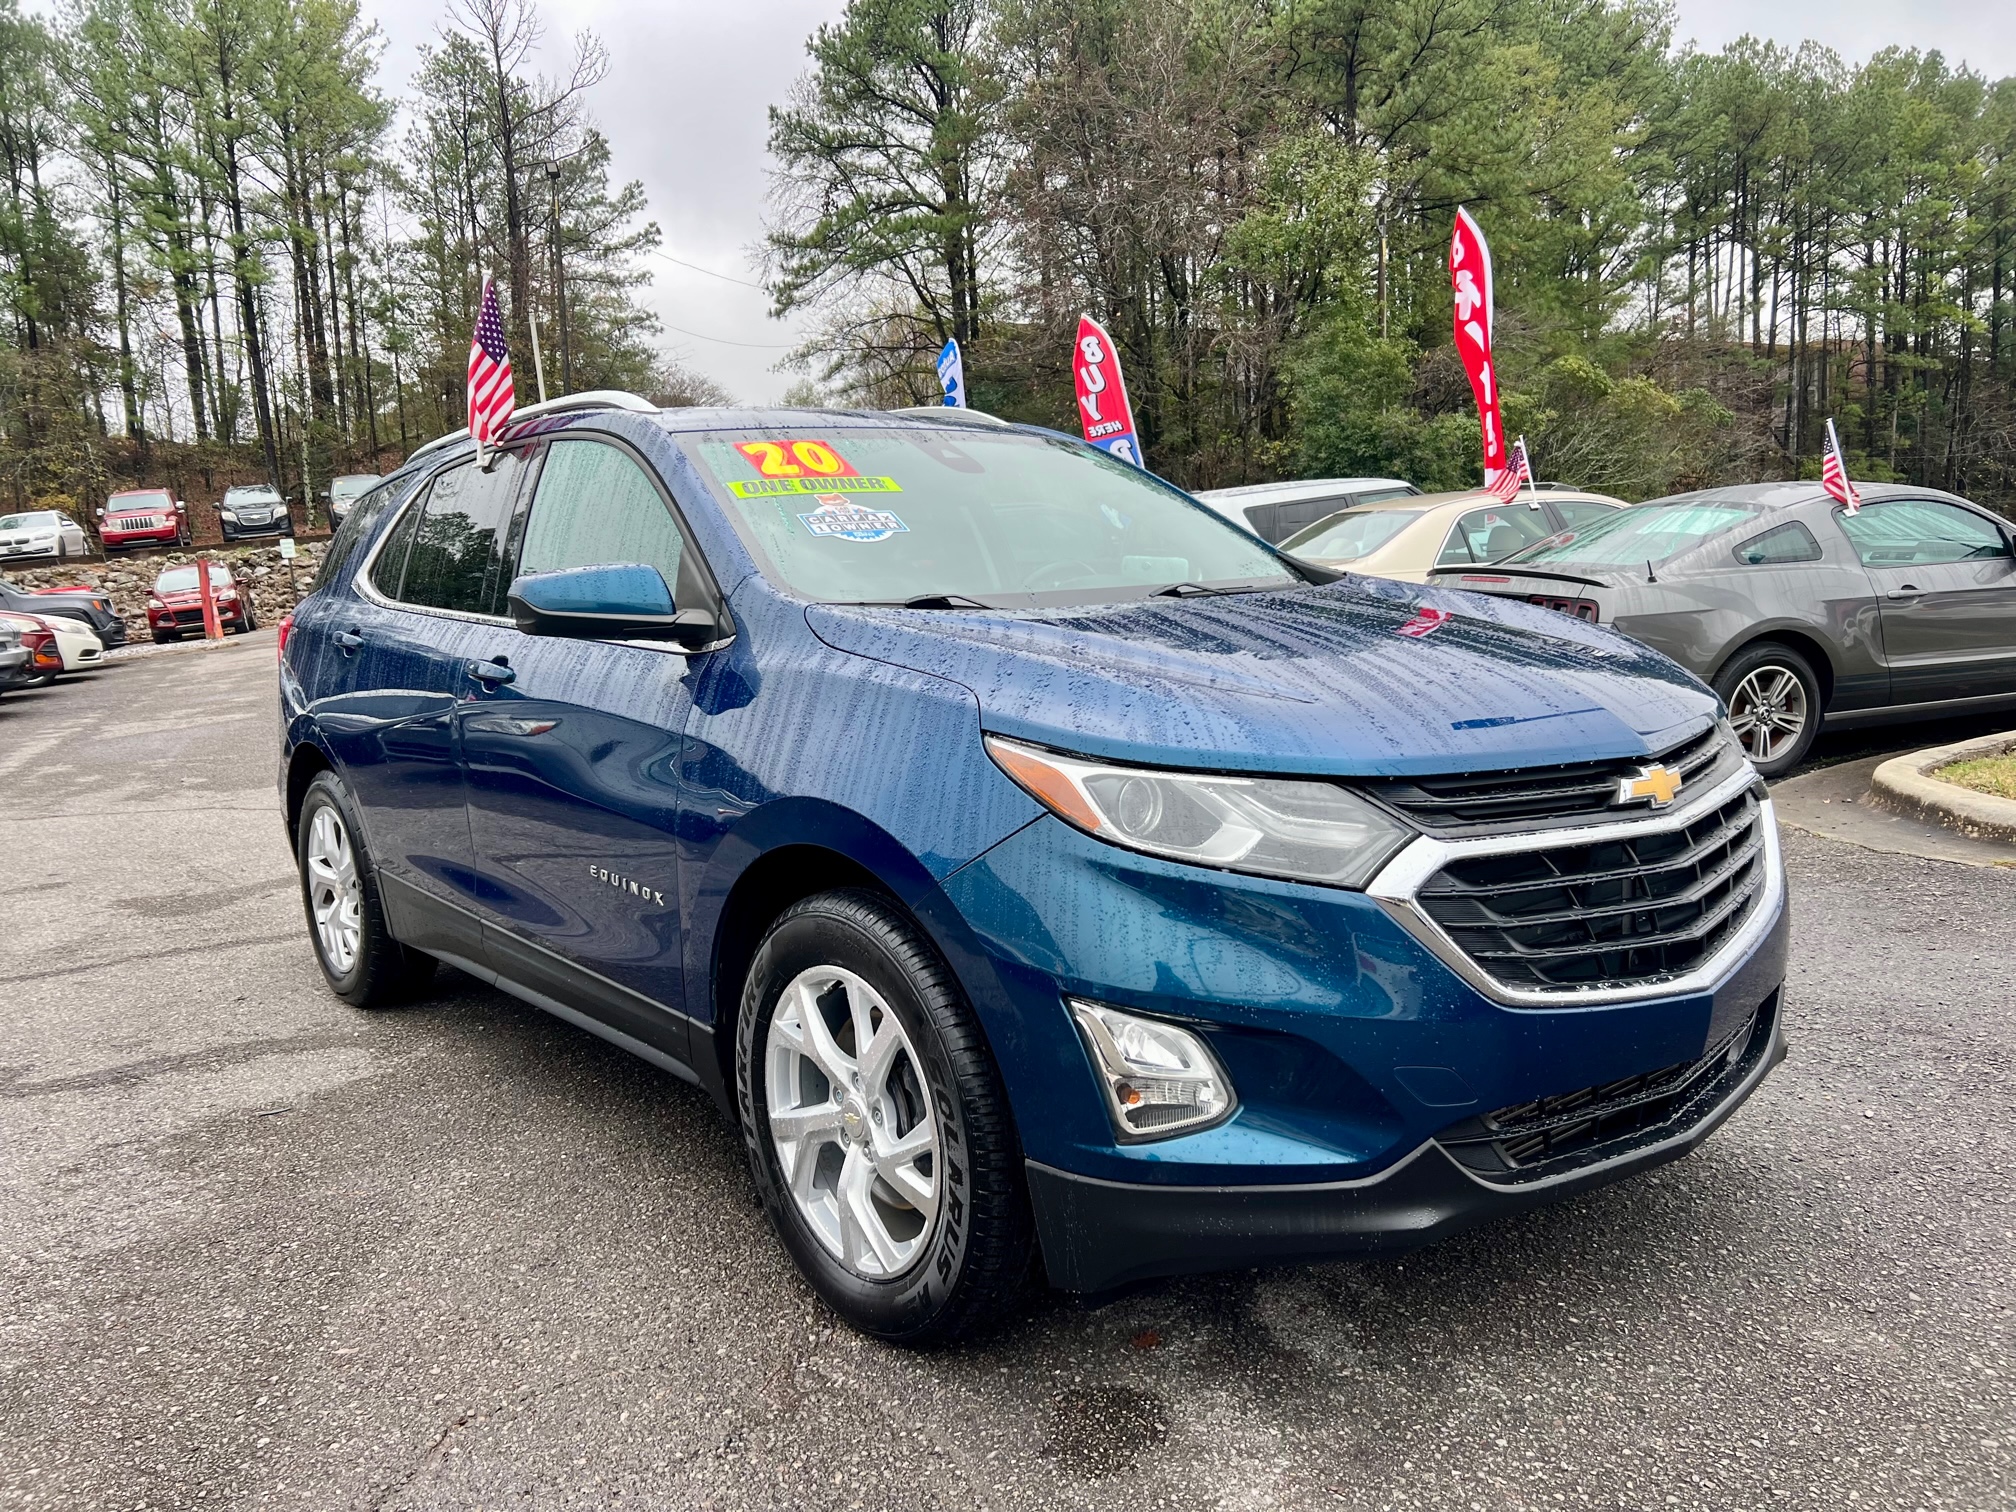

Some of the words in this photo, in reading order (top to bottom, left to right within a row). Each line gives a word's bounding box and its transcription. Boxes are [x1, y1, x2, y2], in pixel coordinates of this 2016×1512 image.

[741, 441, 842, 475] 20
[741, 480, 797, 495] ONE
[799, 477, 887, 492] OWNER
[807, 513, 895, 524] CARFAX
[830, 521, 900, 533] OWNER
[589, 864, 665, 907] EQUINOX
